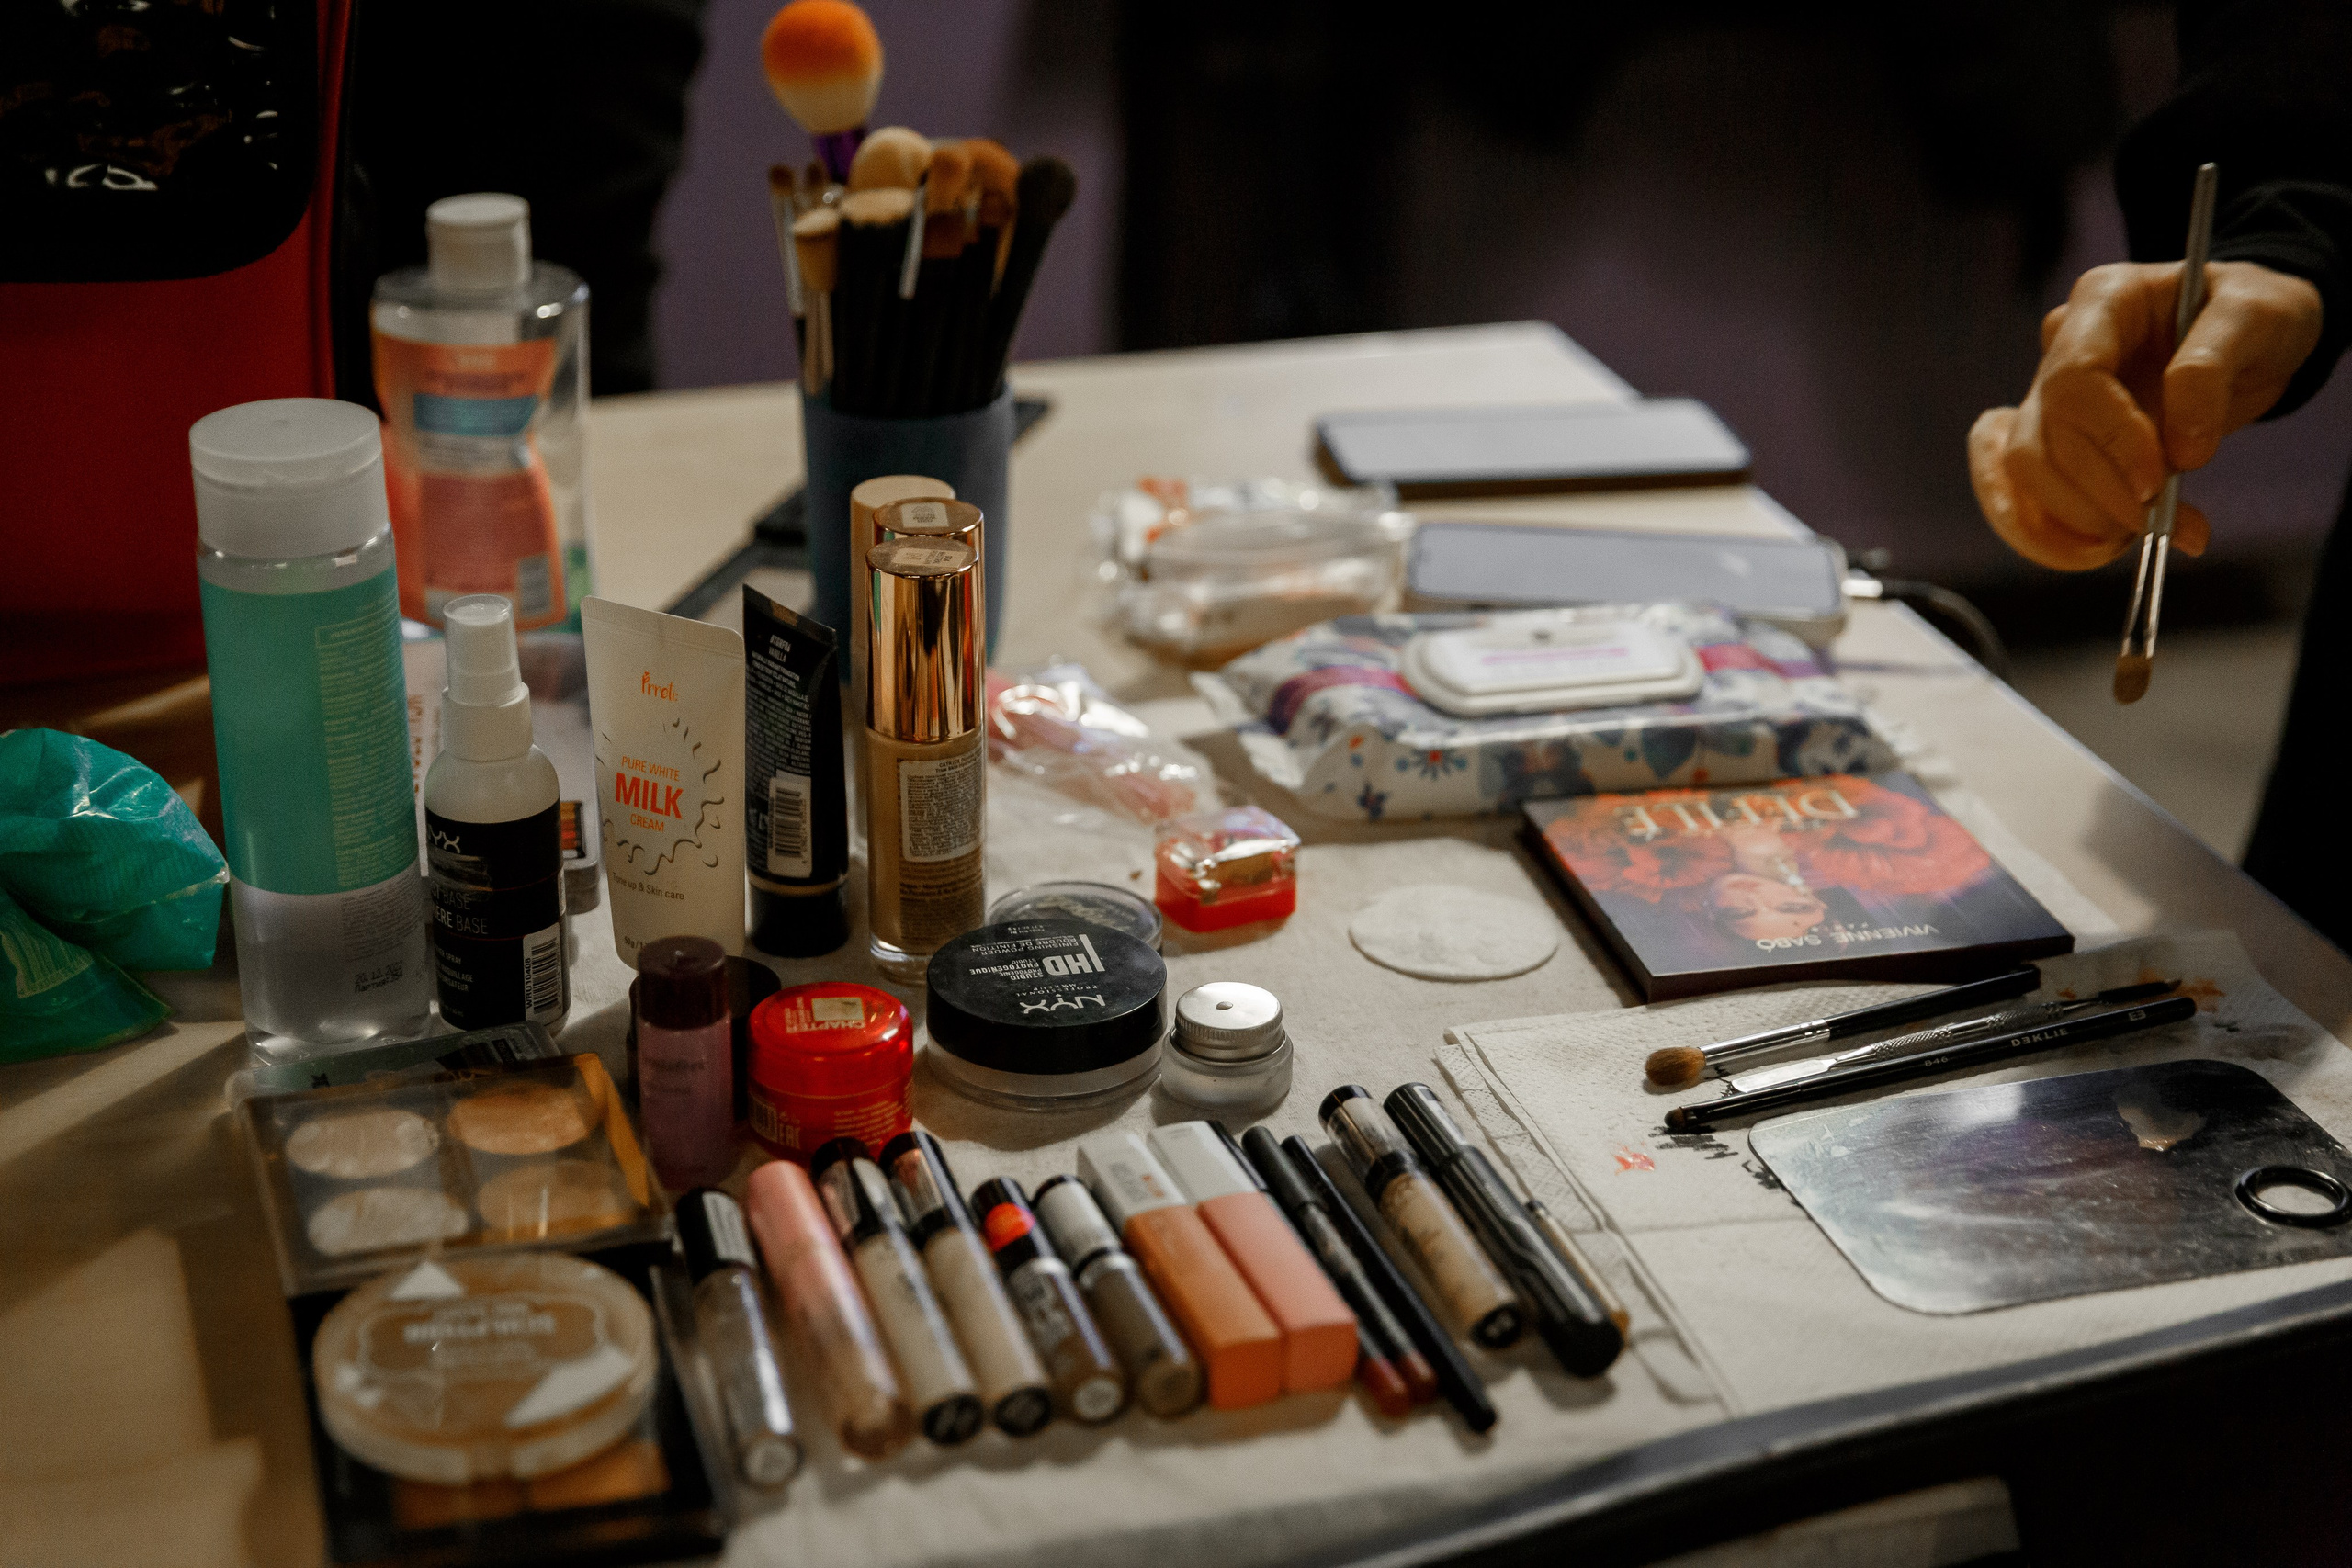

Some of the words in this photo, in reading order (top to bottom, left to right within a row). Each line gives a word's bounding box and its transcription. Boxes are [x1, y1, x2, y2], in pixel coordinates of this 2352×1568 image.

[622, 756, 647, 773] PURE
[649, 761, 680, 782] WHITE
[615, 773, 684, 819] MILK
[630, 813, 664, 833] CREAM
[443, 888, 470, 911] BASE
[628, 881, 637, 891] up
[638, 881, 645, 892] &
[646, 884, 662, 897] Skin
[664, 890, 684, 901] care
[456, 913, 488, 935] BASE
[1829, 924, 1939, 944] VIVIENNE
[972, 942, 1017, 953] FINITION
[981, 946, 1024, 956] POWDER
[1027, 942, 1079, 951] FINISHING
[1011, 957, 1037, 965] STUDIO
[1042, 953, 1093, 976] HD
[524, 957, 533, 1009] WRU10408
[1010, 971, 1044, 981] STUDIO
[1015, 985, 1098, 998] PROFESSIONAL
[1019, 994, 1106, 1015] NYX
